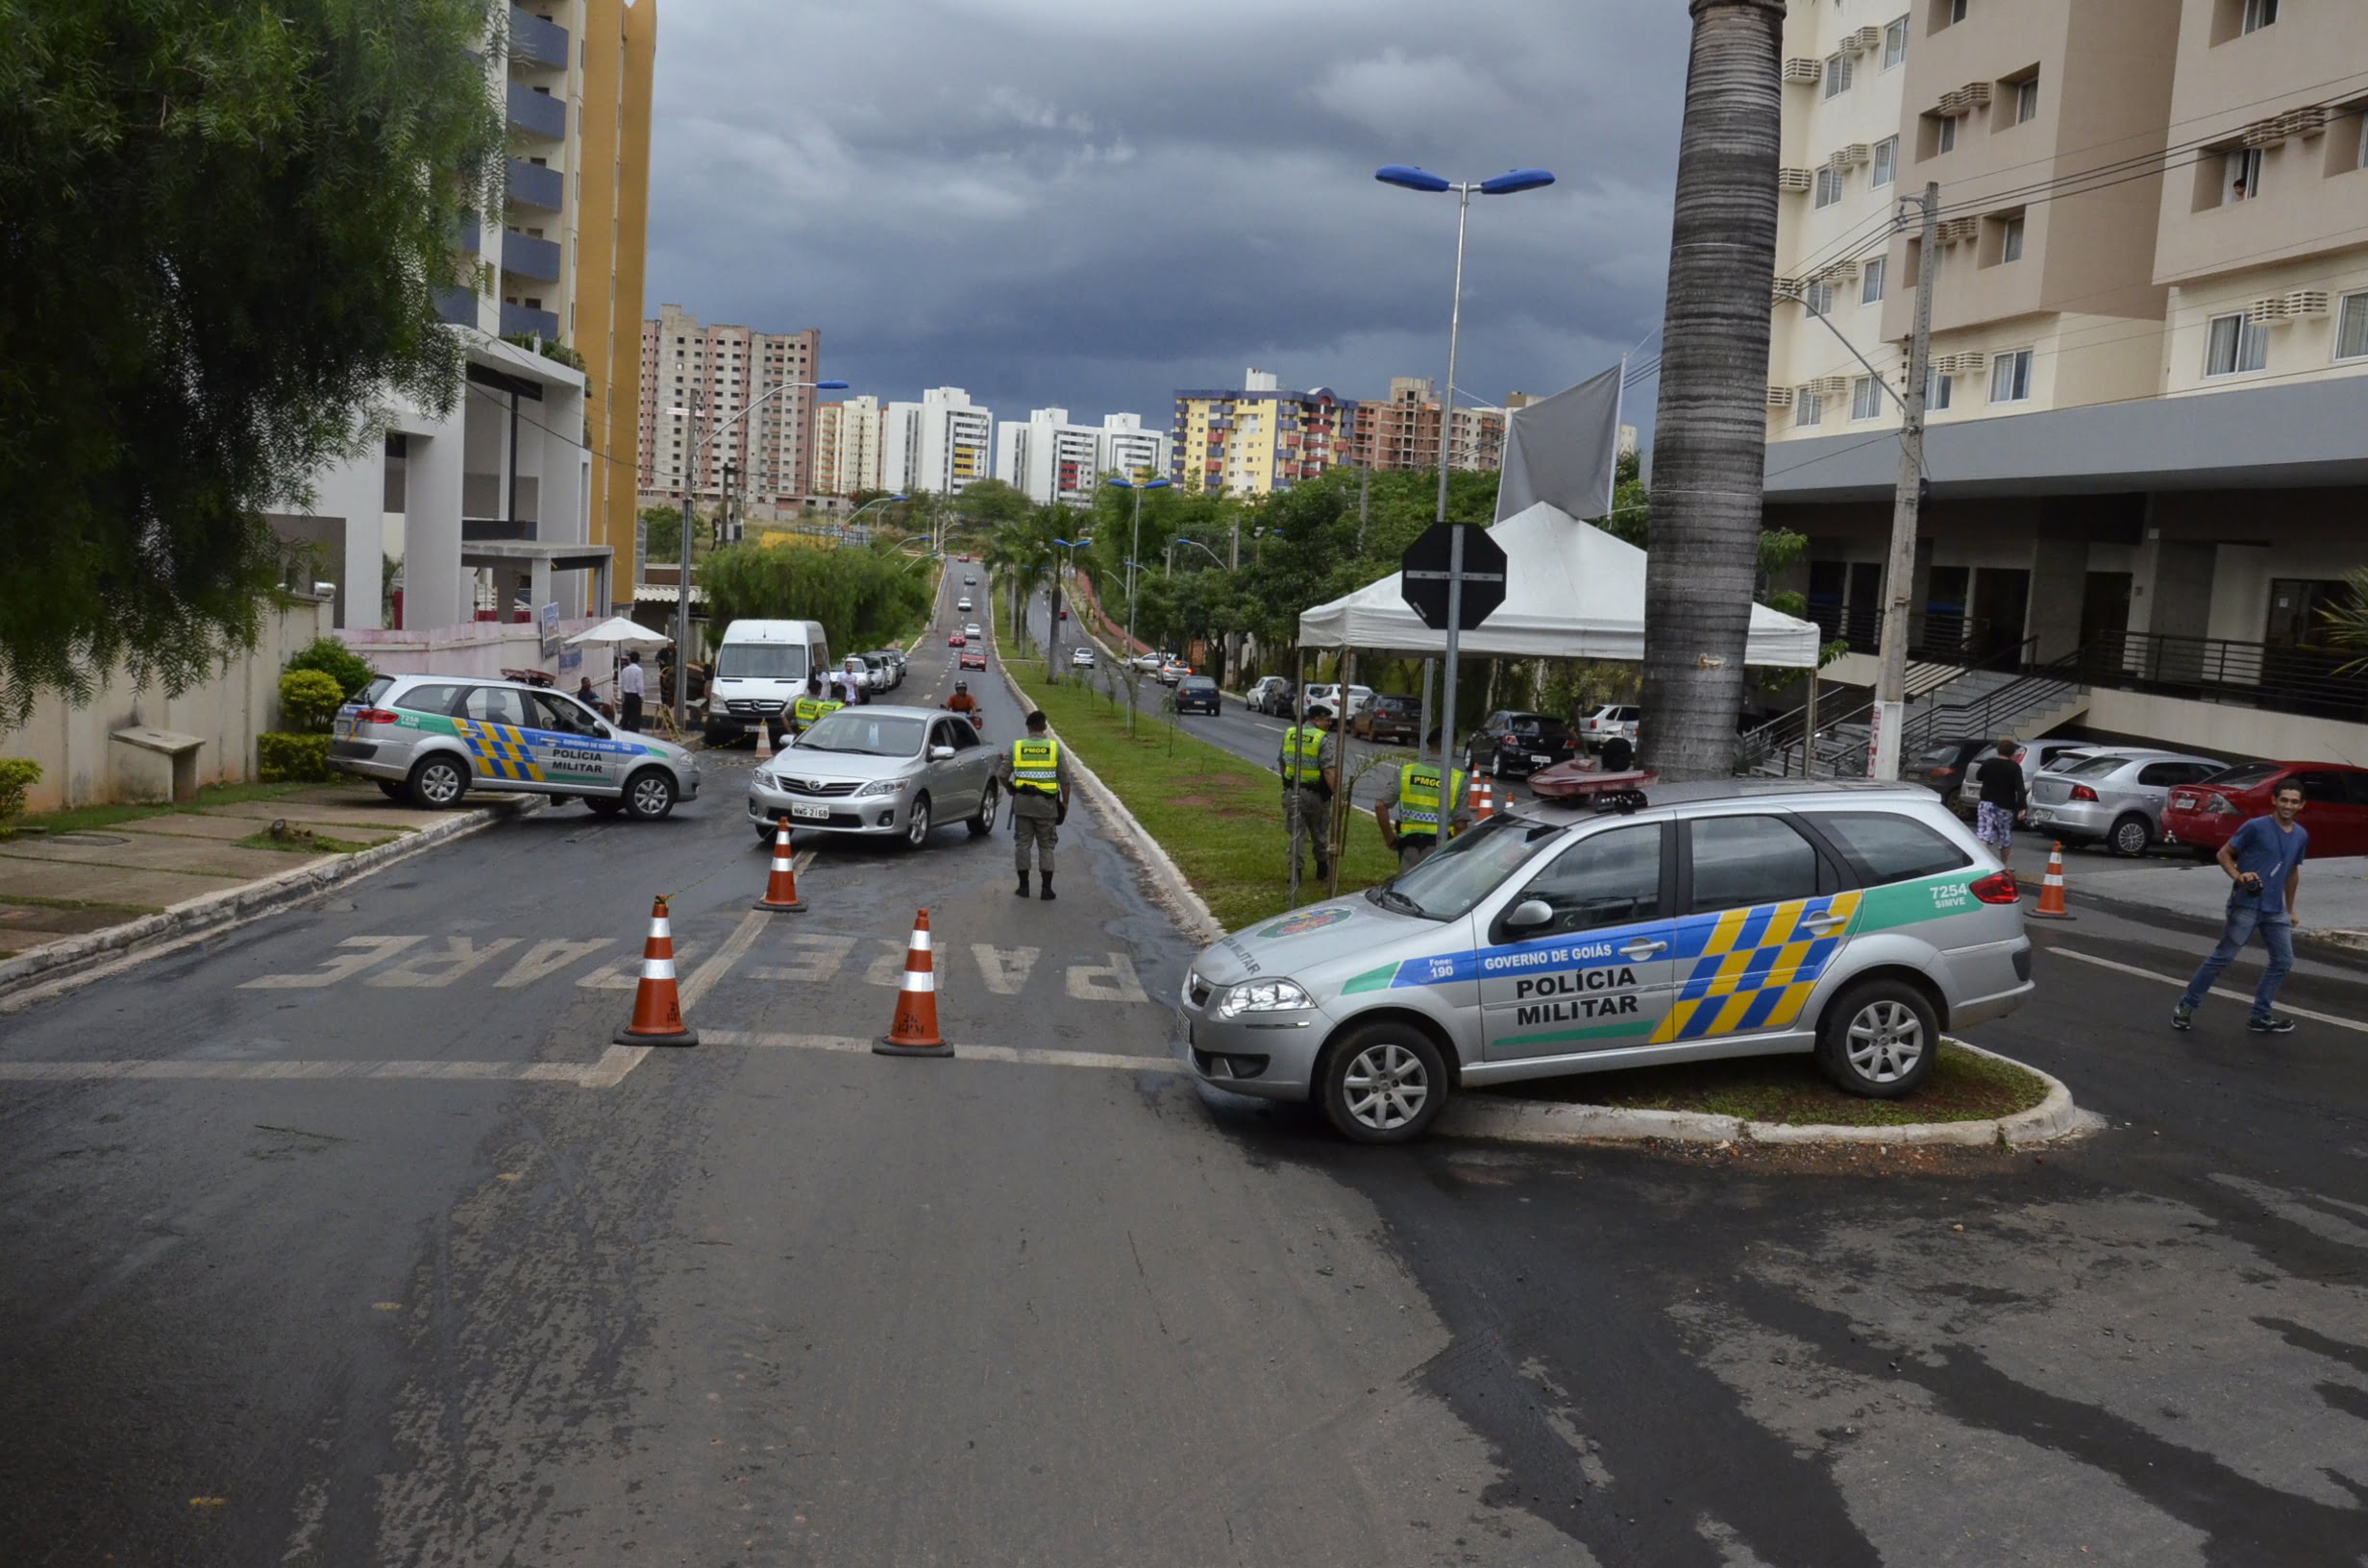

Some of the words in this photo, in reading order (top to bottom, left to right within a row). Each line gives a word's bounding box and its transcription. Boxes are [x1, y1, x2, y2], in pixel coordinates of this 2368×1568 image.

[563, 739, 590, 747] GOVERNO
[1292, 733, 1311, 743] PGO
[553, 748, 603, 762] POLÍCIA
[553, 761, 603, 773] MILITAR
[1930, 883, 1968, 899] 7254
[1935, 896, 1967, 909] SIMVE
[1484, 952, 1548, 970] GOVERNO
[1551, 949, 1569, 962] DE
[1572, 943, 1613, 960] GOIÁS
[1429, 959, 1453, 968] Fone:
[1430, 966, 1454, 978] 190
[1517, 967, 1637, 999] POLÍCIA
[1517, 995, 1639, 1026] MILITAR
